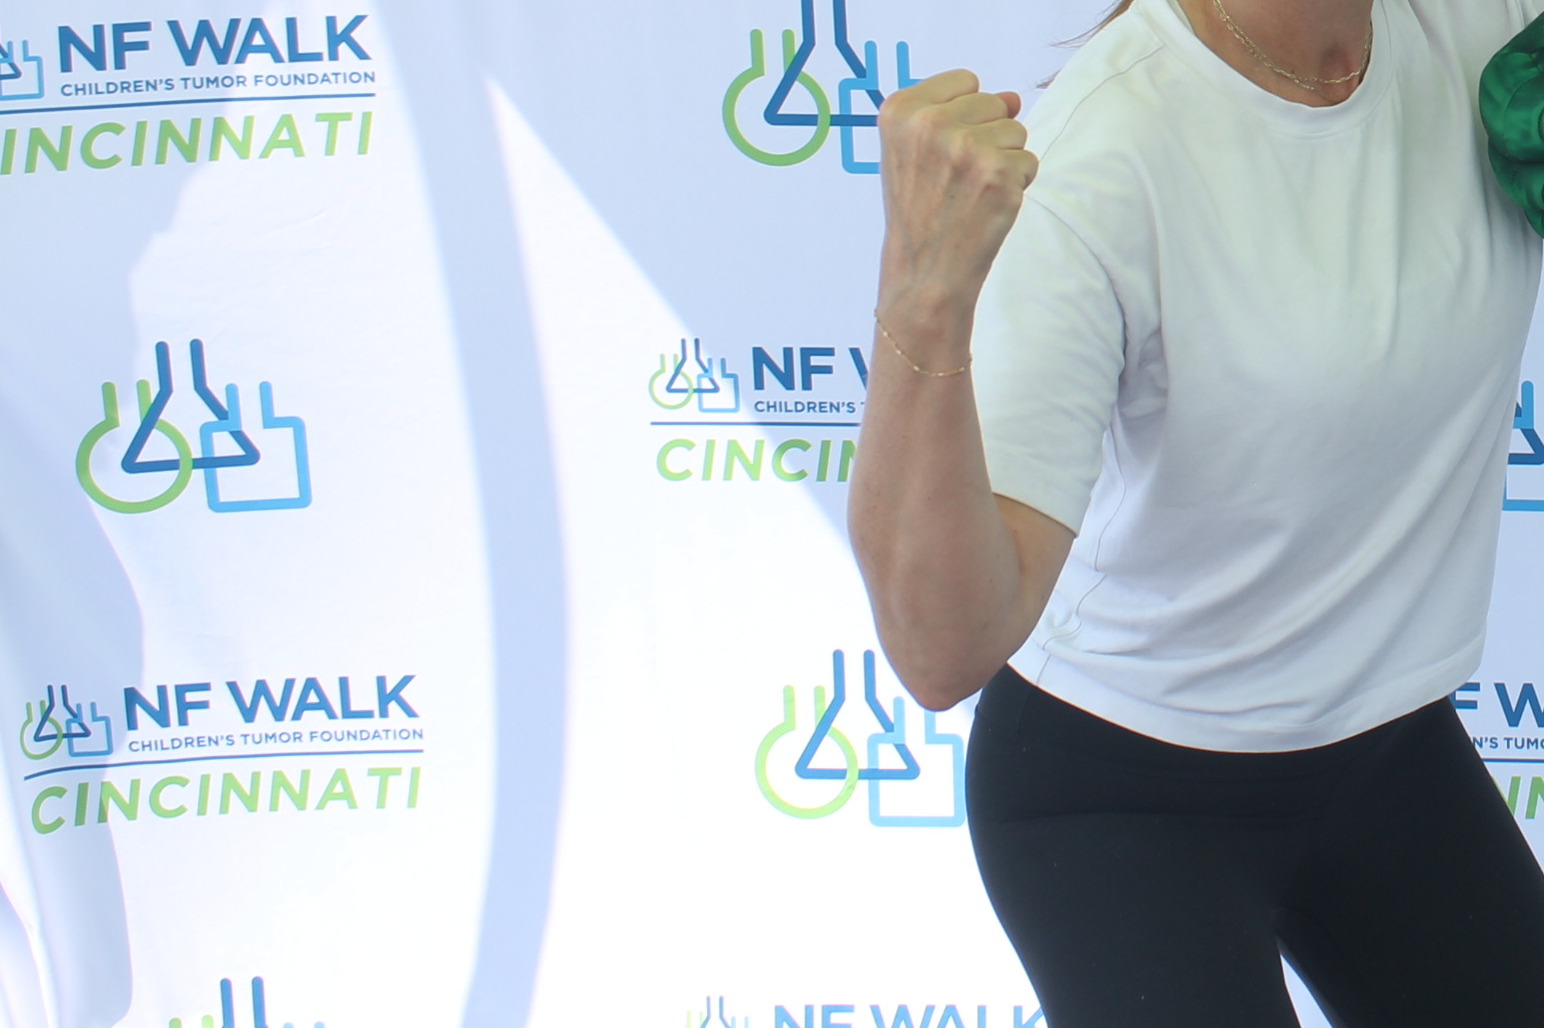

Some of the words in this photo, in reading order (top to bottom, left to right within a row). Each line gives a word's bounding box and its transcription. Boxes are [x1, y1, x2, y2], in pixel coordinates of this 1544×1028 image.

[58, 22, 151, 73] NF
[167, 15, 370, 66] WALK
[60, 78, 174, 96] CHILDREN'S
[182, 76, 247, 90] TUMOR
[254, 72, 374, 86] FOUNDATION
[752, 347, 835, 391] NF
[754, 401, 855, 413] CHILDREN'S
[124, 683, 210, 730] NF
[226, 676, 418, 723] WALK
[128, 735, 235, 752] CHILDREN'S
[241, 732, 304, 745] TUMOR
[310, 729, 423, 743] FOUNDATION
[32, 767, 421, 834] CINCINNATI
